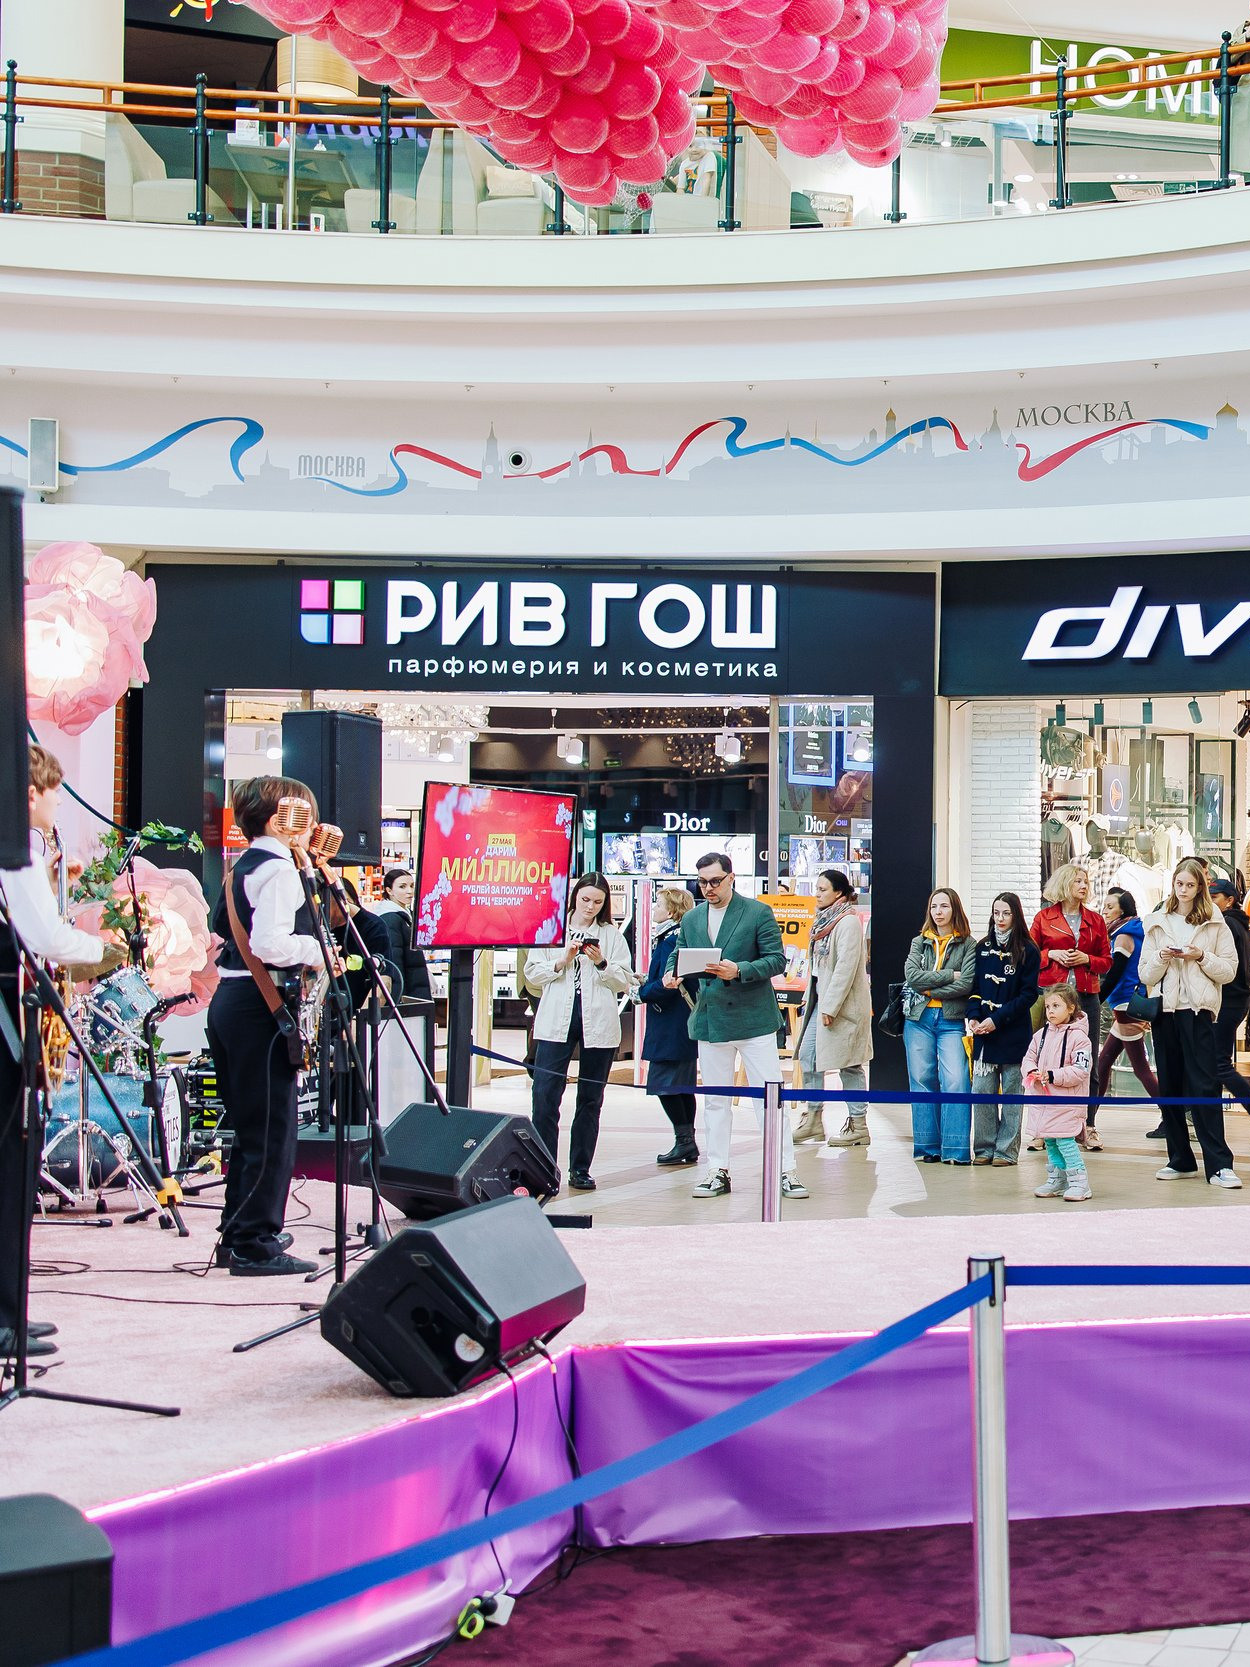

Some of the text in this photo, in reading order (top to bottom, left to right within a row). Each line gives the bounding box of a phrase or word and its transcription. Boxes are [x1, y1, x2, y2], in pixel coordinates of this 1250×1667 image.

[1016, 400, 1134, 428] МОСКВА
[298, 454, 366, 478] МОСКВА
[386, 579, 777, 650] РИВ ГОШ
[388, 657, 778, 679] парфюмерия и косметика
[663, 812, 711, 832] Dior
[804, 814, 827, 834] Dior
[486, 847, 516, 857] ДАРИМ
[441, 857, 555, 884] МИЛЛИОН
[462, 884, 533, 896] РУБЛЕЙ ЗА ПОКУПКИ
[477, 897, 490, 907] ТРЦ
